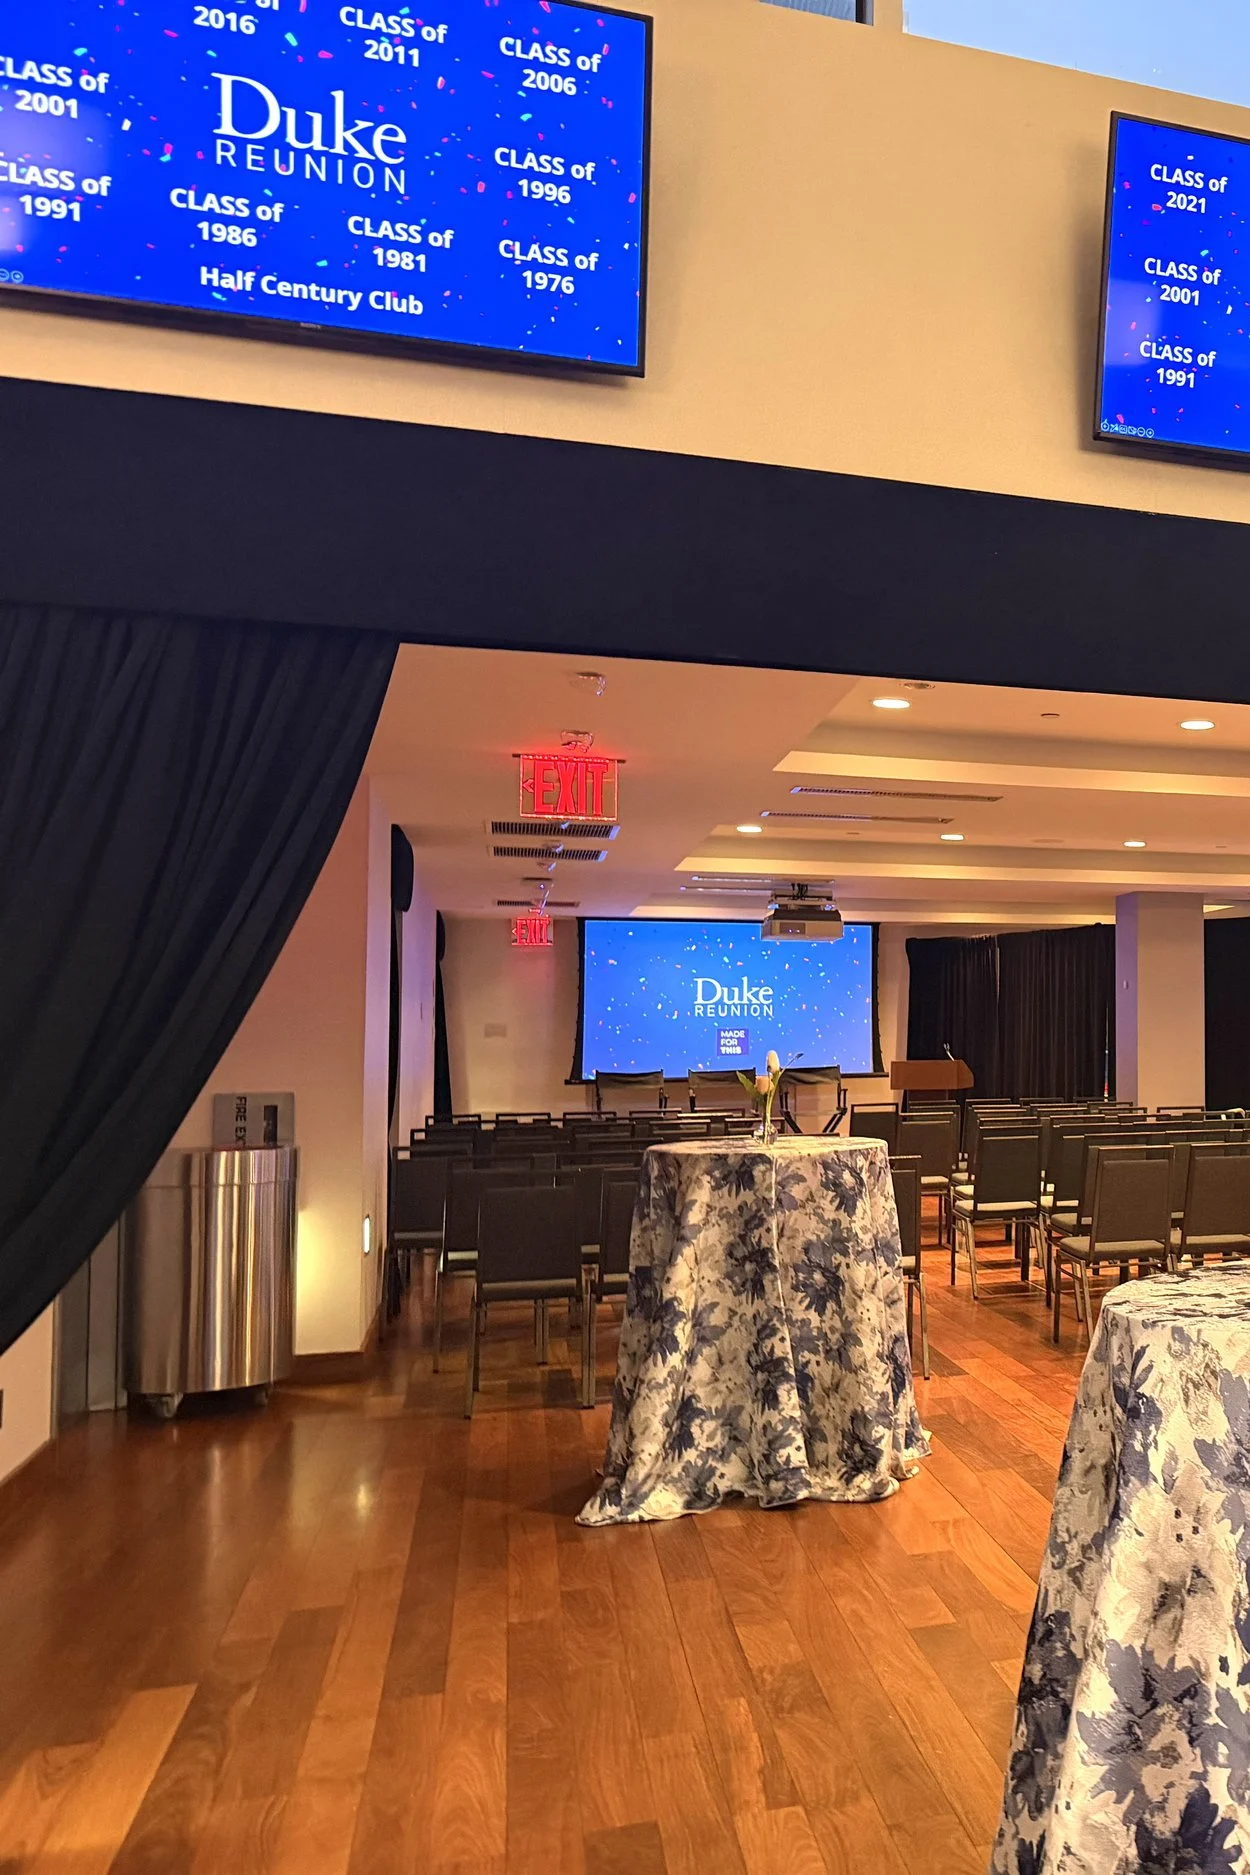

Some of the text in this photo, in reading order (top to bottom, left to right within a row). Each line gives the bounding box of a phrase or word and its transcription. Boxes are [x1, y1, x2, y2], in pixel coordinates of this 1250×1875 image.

[193, 5, 256, 35] 2016
[339, 6, 448, 44] CLASS of
[364, 39, 419, 67] 2011
[499, 36, 602, 73] CLASS of
[79, 72, 110, 94] of
[522, 68, 577, 96] 2006
[14, 89, 78, 119] 2001
[211, 72, 407, 167] Duke
[216, 137, 407, 195] REUNION
[494, 147, 596, 181] CLASS of
[1150, 163, 1228, 193] CLASS of
[81, 175, 112, 197] of
[518, 178, 571, 204] 1996
[18, 194, 81, 222] 1991
[170, 188, 285, 223] CLASS of
[1166, 191, 1206, 214] 2021
[197, 221, 257, 247] 1986
[347, 215, 455, 249] CLASS of
[372, 247, 426, 273] 1981
[498, 239, 600, 271] CLASS of
[522, 270, 575, 295] 1976
[1144, 257, 1222, 286] CLASS of
[200, 266, 424, 315] Half Century Club
[1159, 284, 1200, 306] 2001
[1139, 340, 1217, 368] CLASS of
[1156, 367, 1195, 388] 1991
[534, 760, 609, 816] EXIT
[516, 919, 549, 944] EXIT
[693, 975, 774, 1005] Duke
[694, 1004, 774, 1018] REUNION
[720, 1030, 746, 1039] MADE
[720, 1038, 738, 1047] FOR
[235, 1096, 248, 1122] FIRE
